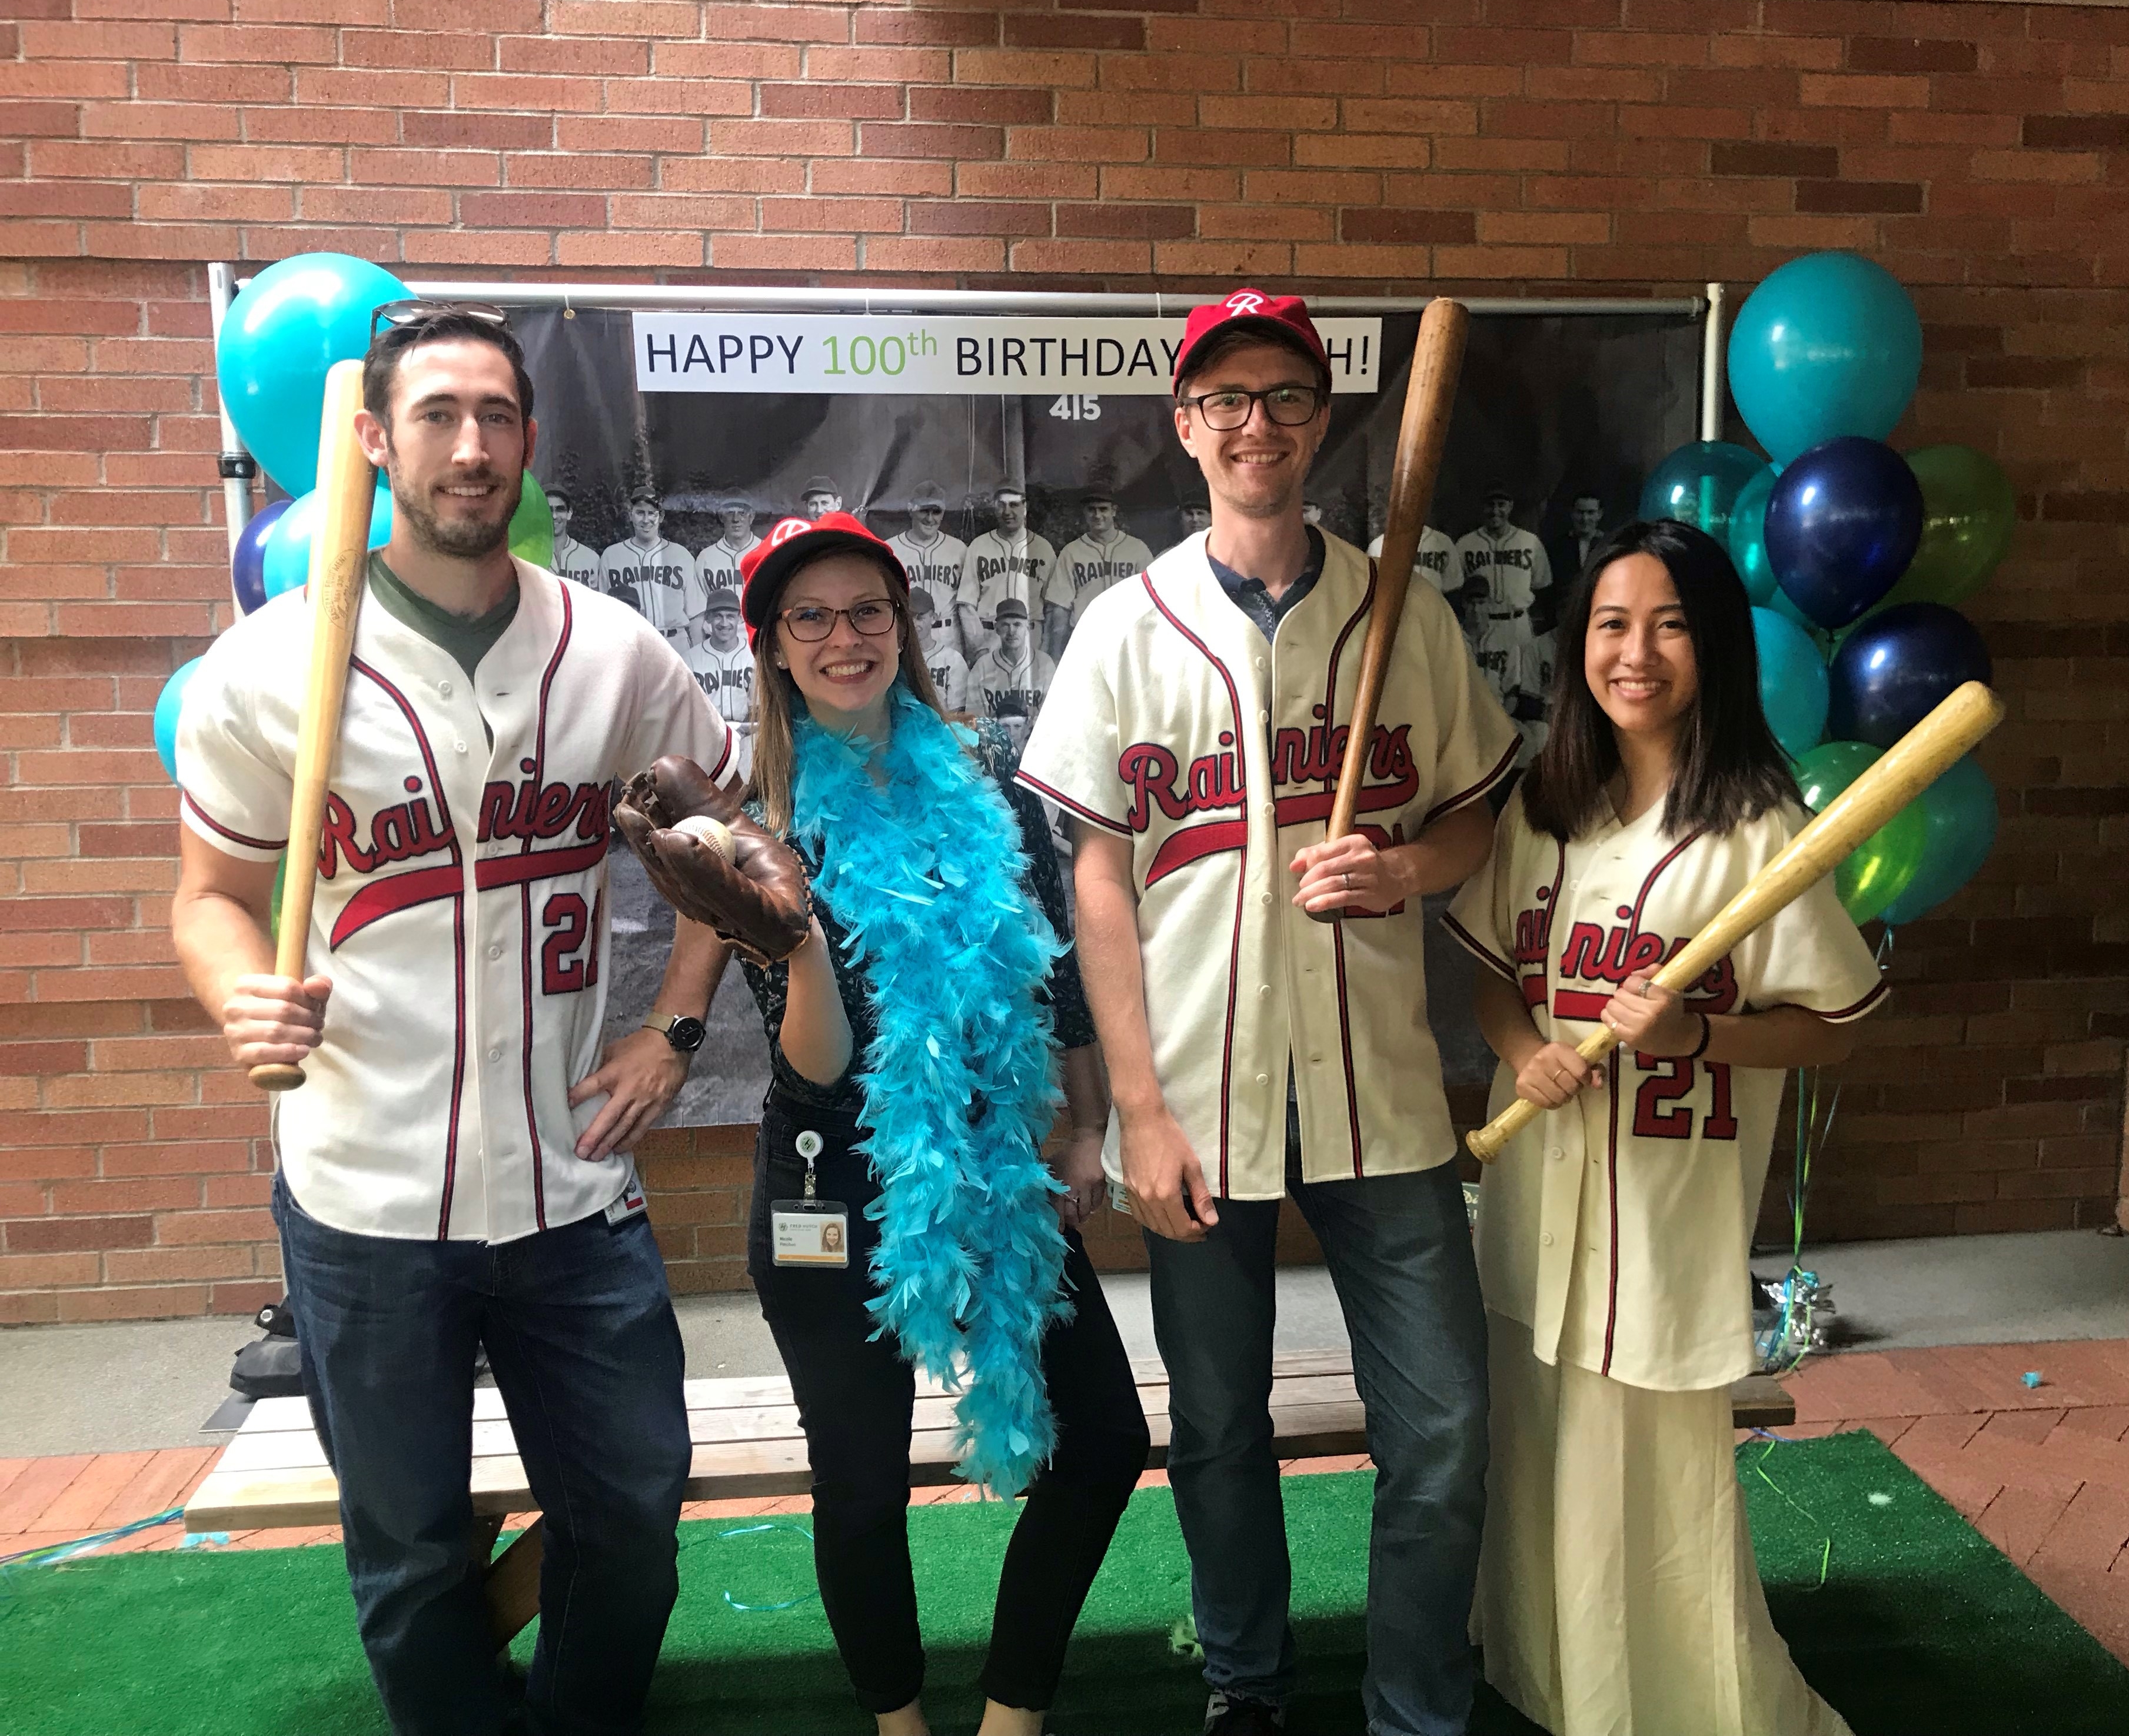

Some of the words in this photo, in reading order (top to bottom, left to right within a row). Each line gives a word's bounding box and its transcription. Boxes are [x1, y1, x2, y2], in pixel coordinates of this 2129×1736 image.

[647, 333, 804, 375] HAPPY
[822, 328, 937, 376] 100th
[956, 337, 1185, 377] BIRTHDAY
[1049, 394, 1102, 421] 415
[1632, 1050, 1738, 1140] 21
